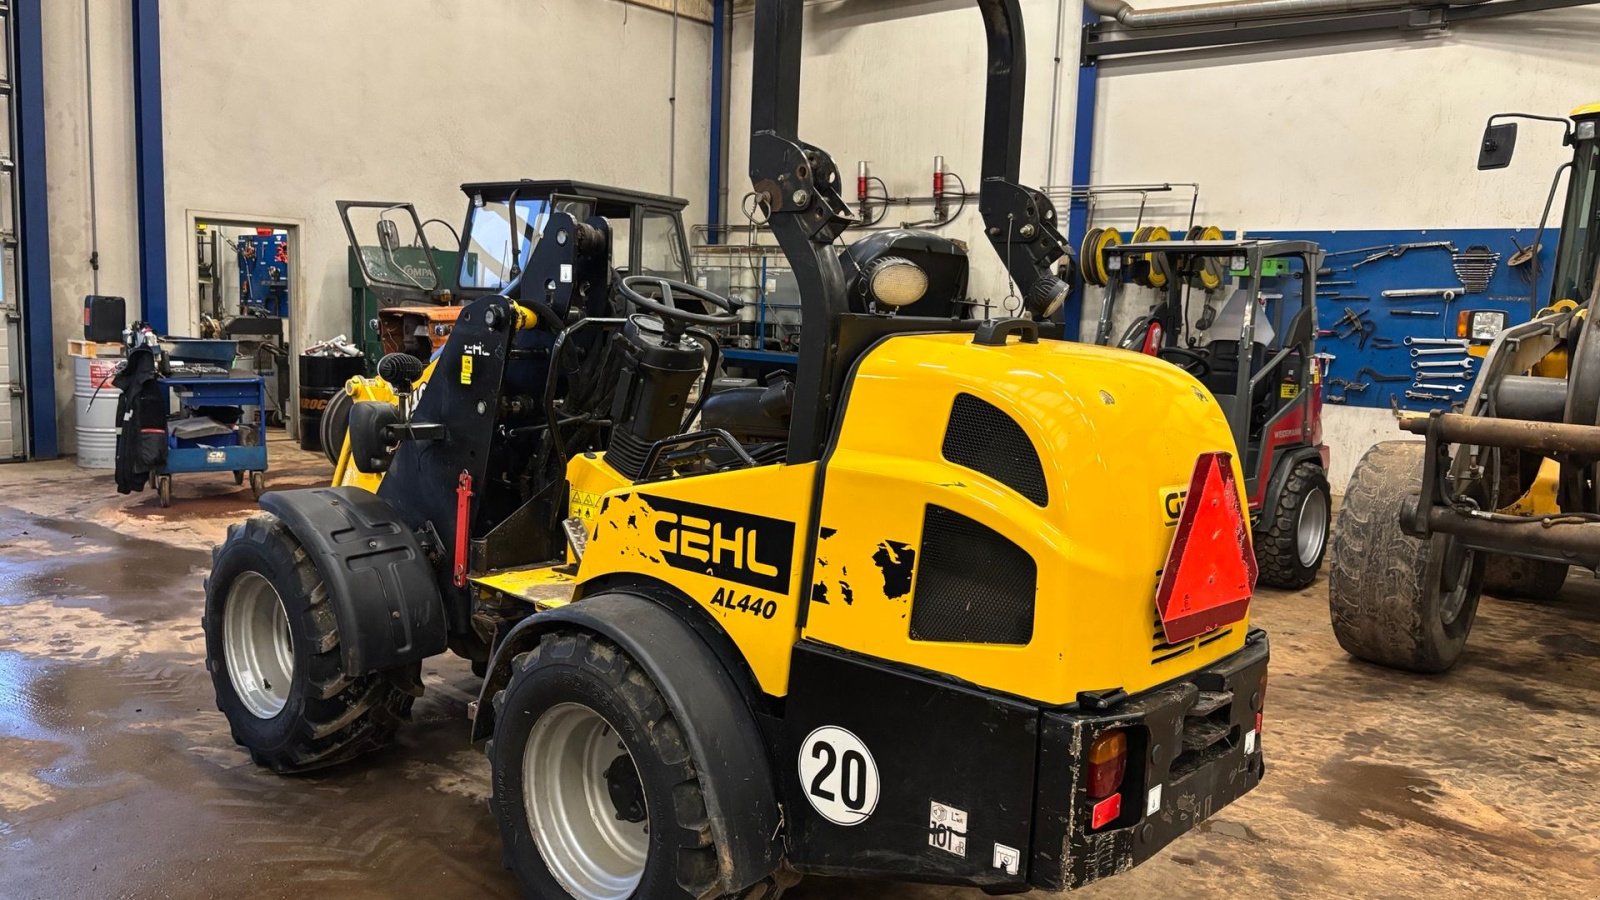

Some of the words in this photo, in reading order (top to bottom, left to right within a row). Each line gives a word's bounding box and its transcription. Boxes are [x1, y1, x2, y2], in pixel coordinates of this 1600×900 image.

[649, 510, 779, 577] GEHL
[710, 587, 778, 620] AL440
[810, 740, 867, 811] 20
[929, 820, 953, 851] 101
